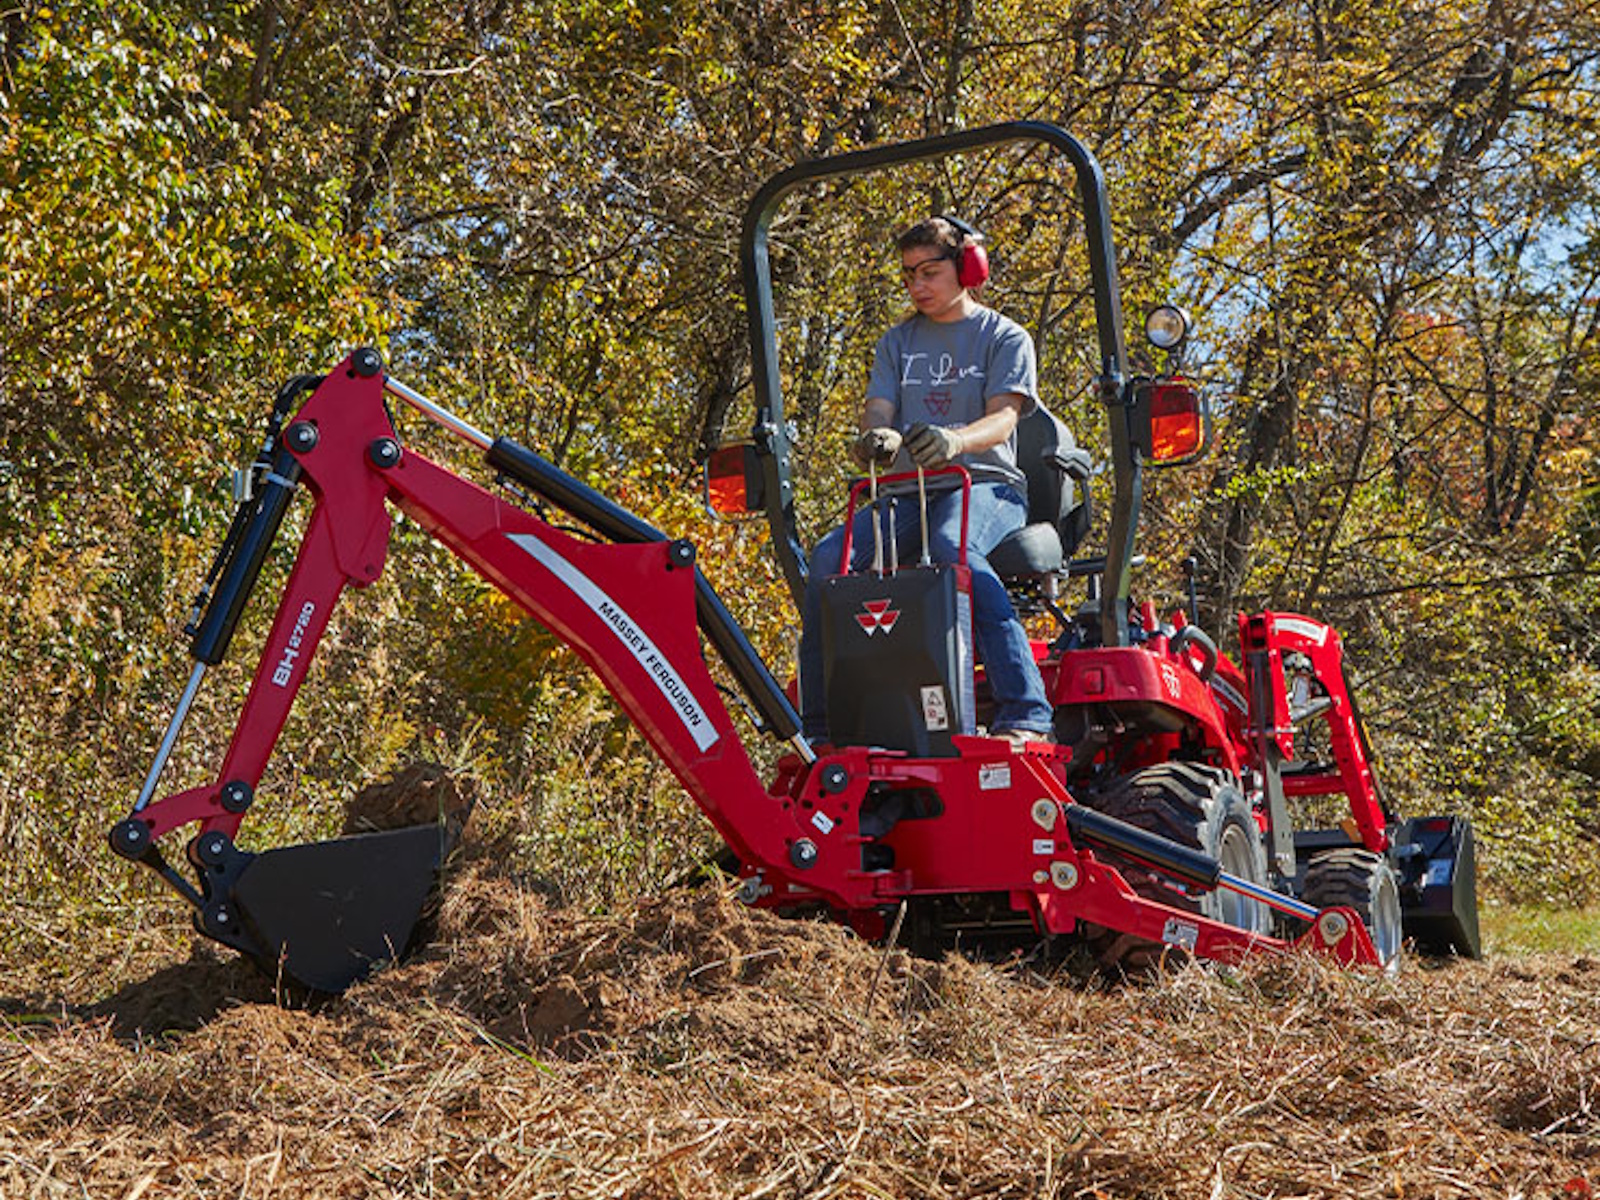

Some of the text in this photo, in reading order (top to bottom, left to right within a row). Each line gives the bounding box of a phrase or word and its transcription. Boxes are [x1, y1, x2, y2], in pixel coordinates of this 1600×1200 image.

[901, 352, 928, 386] I
[599, 602, 702, 727] MASSEY FERGUSON
